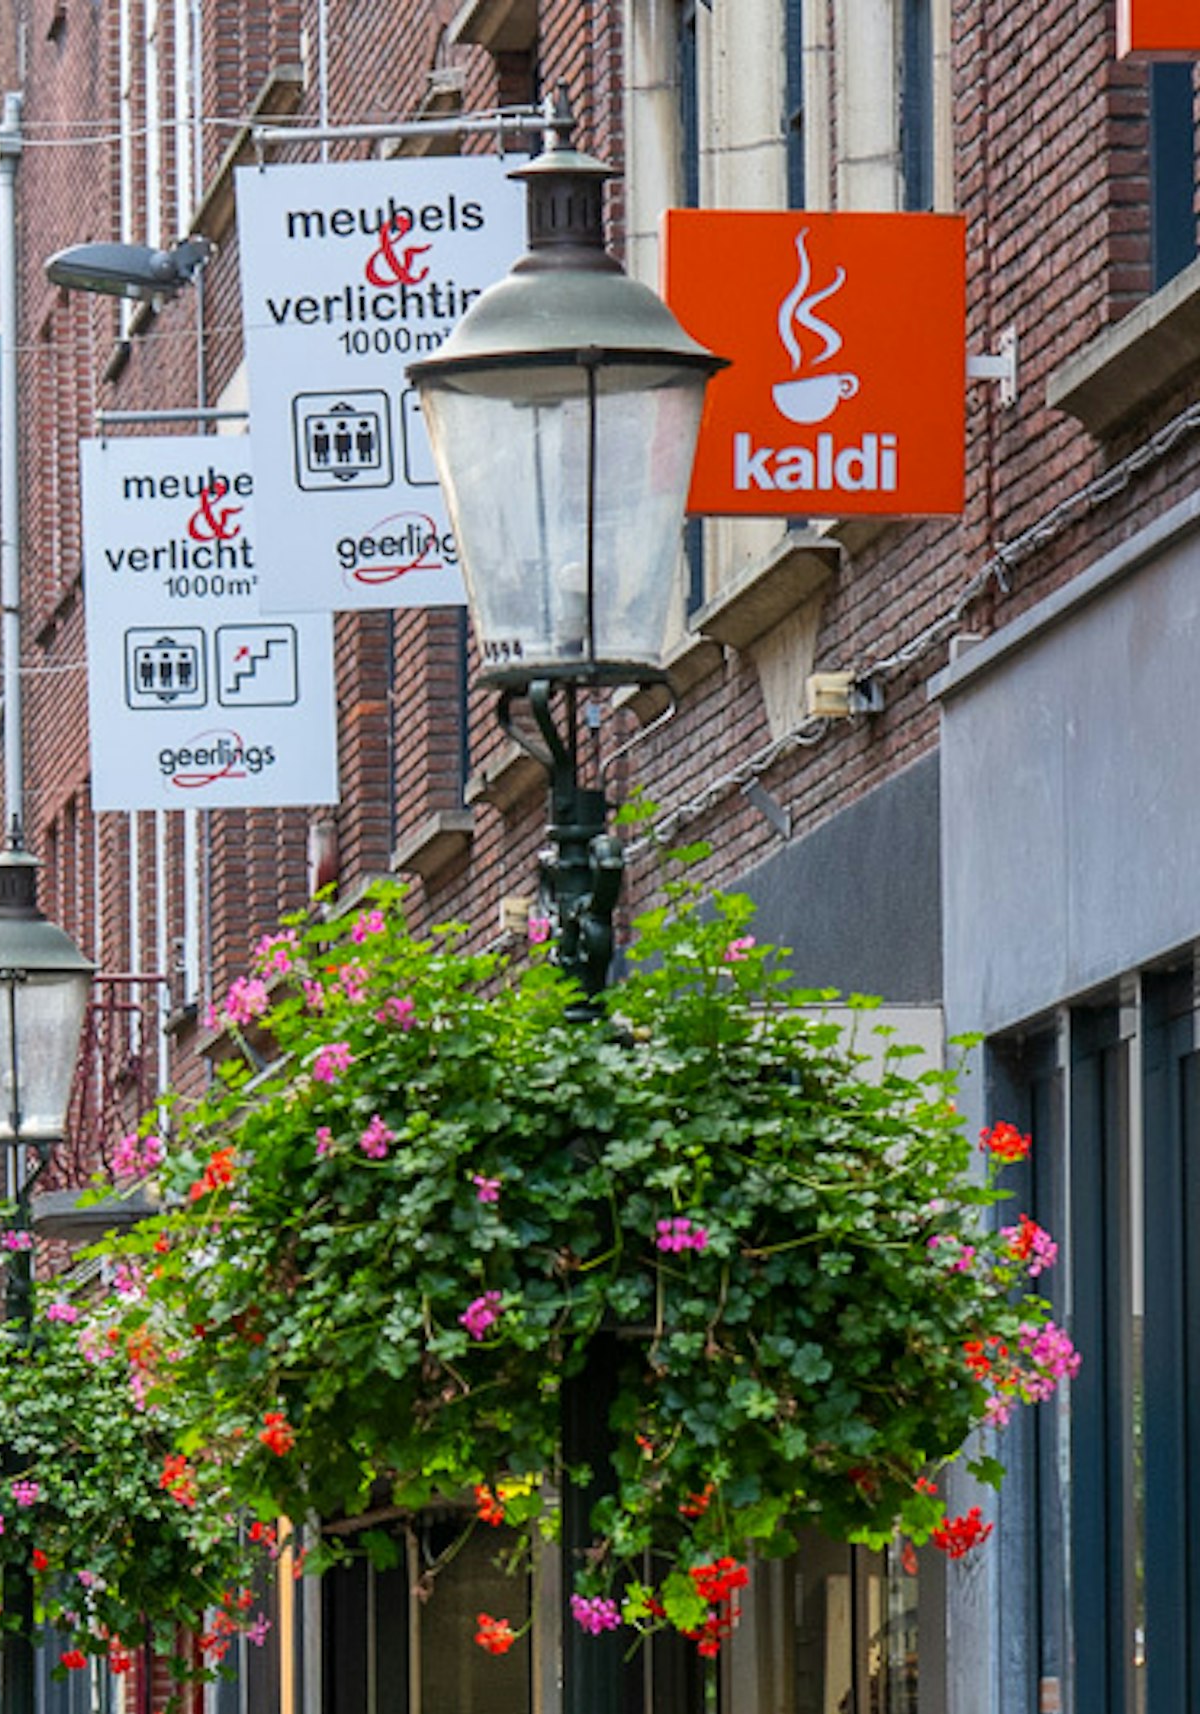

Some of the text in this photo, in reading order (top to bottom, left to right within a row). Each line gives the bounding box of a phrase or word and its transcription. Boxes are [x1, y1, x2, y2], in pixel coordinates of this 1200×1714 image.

[287, 194, 484, 237] meubels
[365, 216, 432, 287] &
[267, 280, 481, 324] verlichtin
[123, 466, 253, 498] meube
[734, 432, 896, 491] kaldi
[188, 483, 243, 541] &
[105, 538, 255, 571] verlicht
[337, 524, 459, 569] geerling
[159, 739, 275, 774] geerlings
